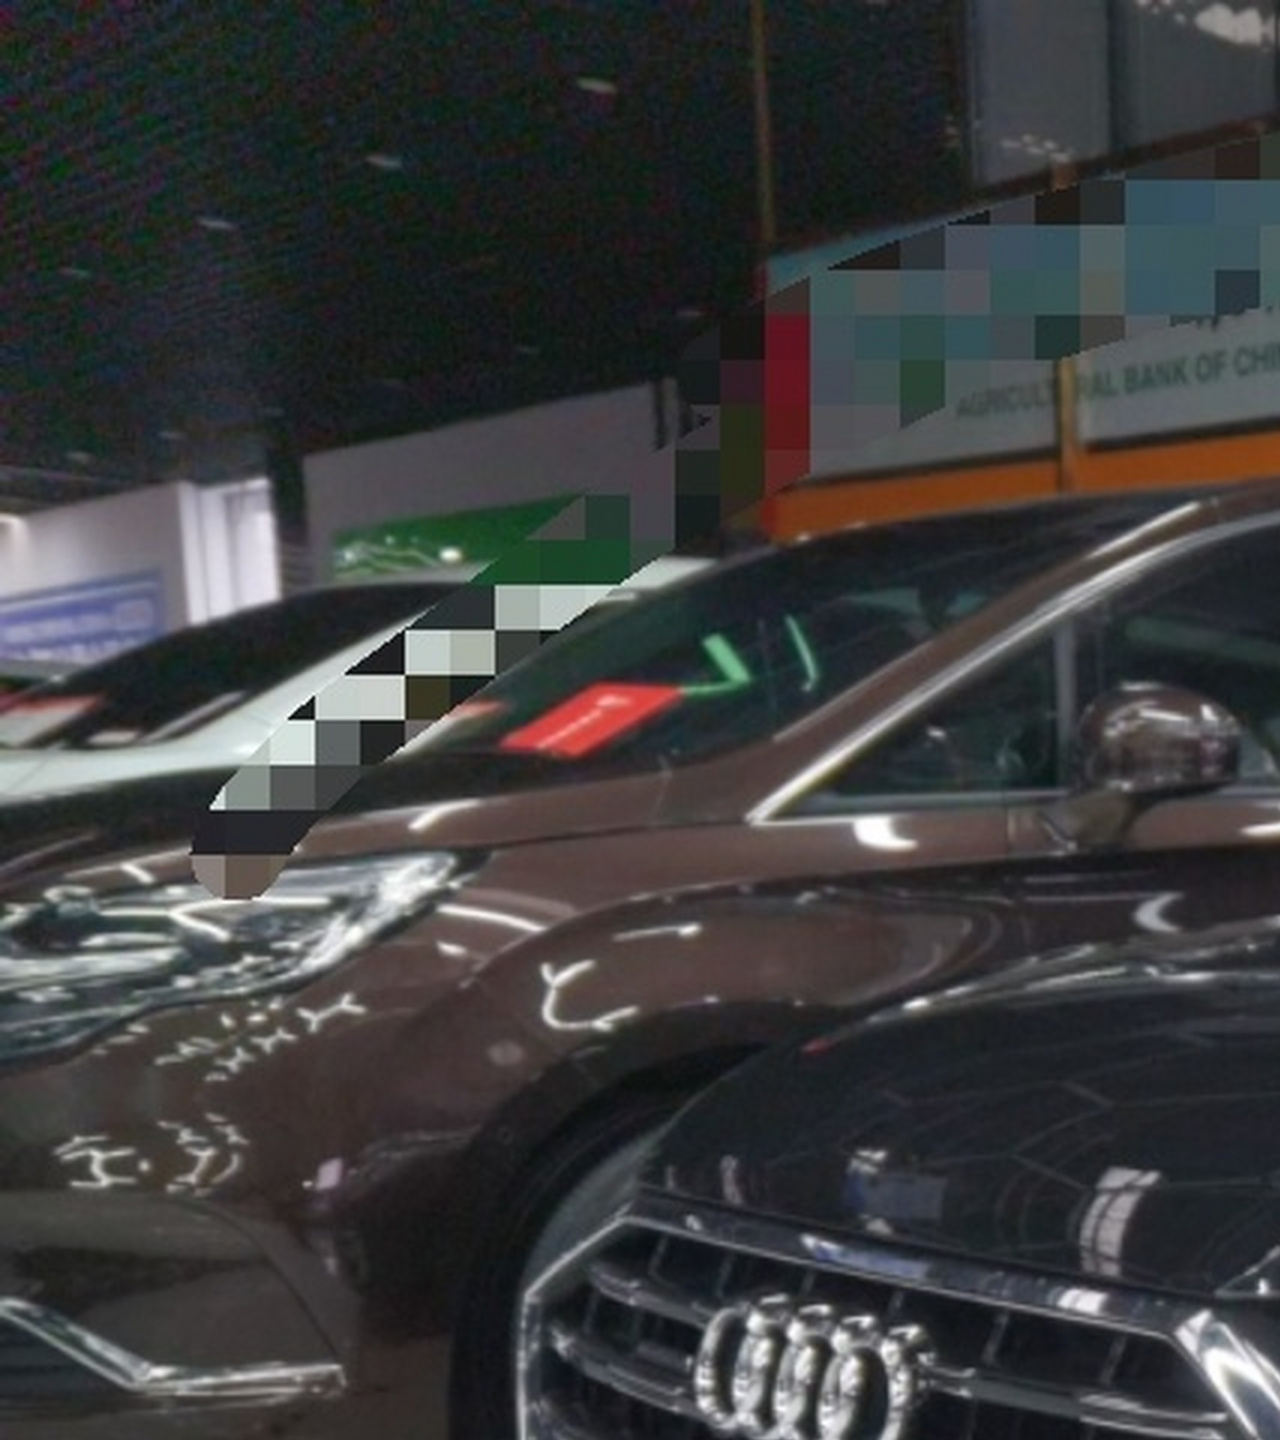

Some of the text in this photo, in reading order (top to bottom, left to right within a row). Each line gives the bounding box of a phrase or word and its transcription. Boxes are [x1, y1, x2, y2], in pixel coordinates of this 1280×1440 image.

[956, 369, 1120, 418] AGRICULTRAL
[1124, 356, 1188, 394] BANK
[1195, 348, 1227, 382] OF
